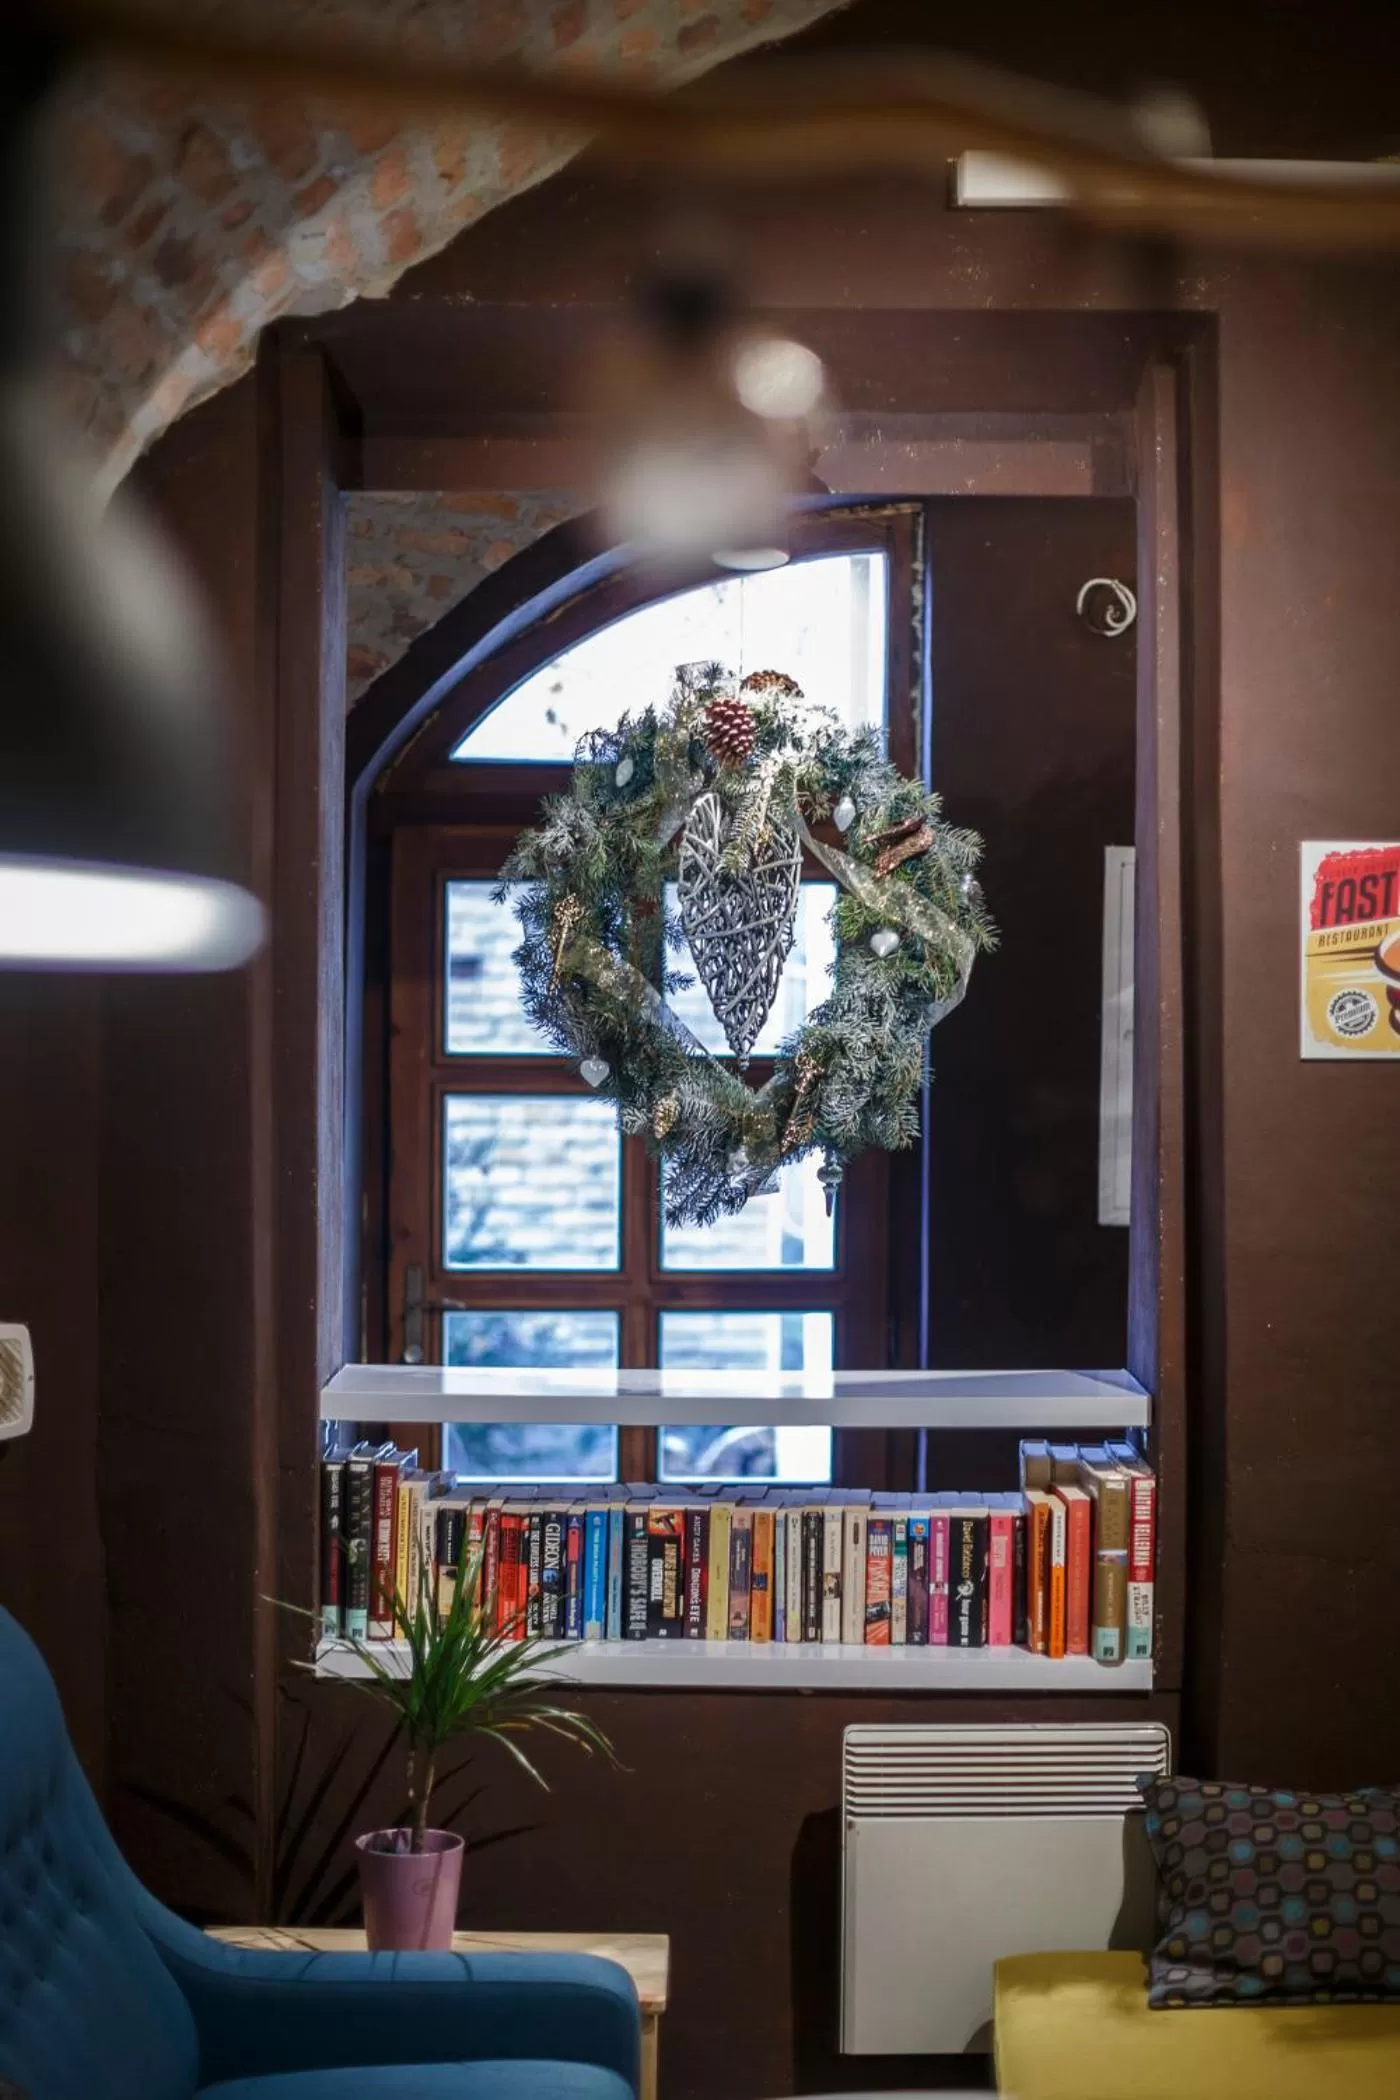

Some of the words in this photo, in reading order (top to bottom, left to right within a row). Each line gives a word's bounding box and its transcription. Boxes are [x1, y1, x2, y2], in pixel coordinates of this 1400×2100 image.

[1320, 869, 1398, 926] FAST
[1318, 923, 1390, 948] RESTAURANT
[544, 1522, 561, 1570] GIDEON
[869, 1534, 888, 1545] DAVID
[962, 1521, 974, 1543] David
[630, 1545, 648, 1595] NOBODY'S
[962, 1544, 974, 1578] Baldacci
[651, 1558, 663, 1601] OVERKILL
[629, 1598, 647, 1620] SAFE
[690, 1605, 700, 1623] EYE
